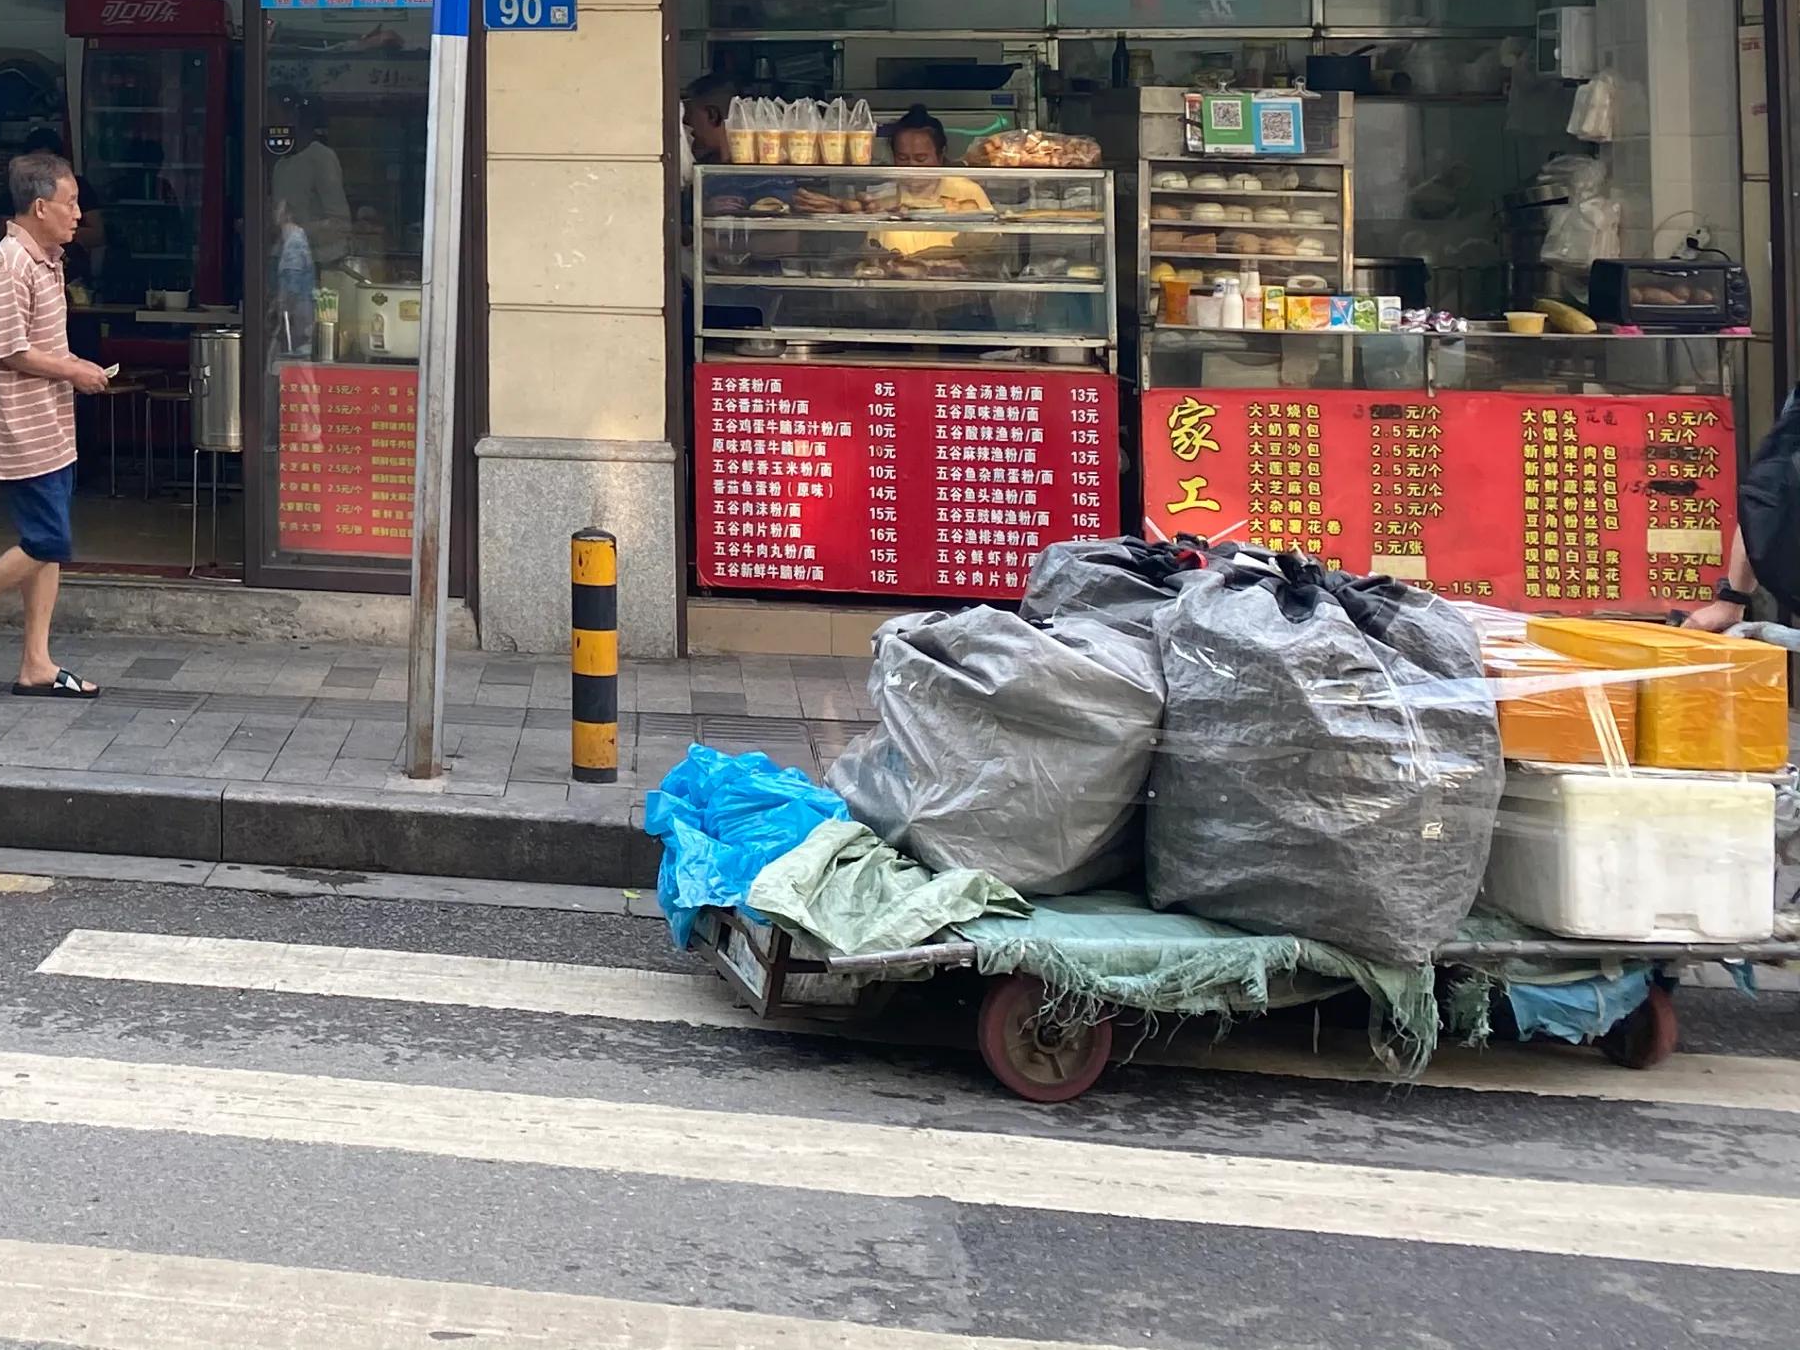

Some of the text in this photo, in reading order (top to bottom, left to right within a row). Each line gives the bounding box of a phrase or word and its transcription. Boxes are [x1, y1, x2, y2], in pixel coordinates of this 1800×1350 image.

[874, 382, 895, 397] 8元
[935, 384, 1099, 403] 五谷金汤渔粉/面 13元
[711, 398, 896, 417] 五谷番茄汁粉/面 10元
[935, 404, 1099, 424] 五谷原味渔粉/面 13元
[1522, 408, 1578, 424] 大馒头
[1647, 411, 1719, 426] 1.5元/个
[868, 424, 896, 438] 10元
[935, 425, 1099, 445] 五谷酸辣渔粉/面 13元
[1248, 422, 1442, 439] 大奶黄包 2.5元/个
[1523, 426, 1698, 443] 小馒头 1元/个
[868, 445, 897, 459] 10元
[935, 445, 1100, 465] 五谷麻辣渔粉/面 13元
[1248, 441, 1442, 459] 大豆沙包 2.5元/个
[1523, 445, 1617, 460] 新鲜猪肉包
[868, 465, 897, 480] 10元
[1167, 396, 1221, 546] 家工
[1371, 463, 1442, 478] 2.5元/个
[1524, 462, 1720, 479] 新鲜牛肉包 3.5元/个
[1071, 472, 1100, 487] 15元
[1524, 479, 1619, 495] 新鲜蔬菜包
[869, 486, 897, 501] 14元
[1249, 480, 1443, 497] 大芝麻包 2.5元/个
[936, 487, 1100, 507] 五谷鱼头渔粉/面 16元
[1249, 501, 1443, 517] 大杂粮包 2.5元/个
[1649, 499, 1721, 513] 2.5元/个
[869, 507, 897, 522] 15元
[1071, 513, 1100, 528] 16元
[1525, 514, 1721, 530] 豆角粉丝包 2.5元/个
[713, 521, 897, 543] 五谷肉片粉/面 16元
[1372, 521, 1424, 536] 2元/个
[1525, 531, 1600, 546] 现磨豆浆
[713, 541, 898, 563] 五谷牛肉丸粉/面 15元
[1374, 540, 1424, 556] 5元/张
[1525, 549, 1620, 564] 现磨白豆浆
[870, 570, 898, 585] 18元
[937, 569, 1028, 587] 五谷肉片粉/
[1525, 565, 1620, 581] 蛋奶大麻花
[1526, 584, 1713, 601] 现做凉拌菜 10元/份
